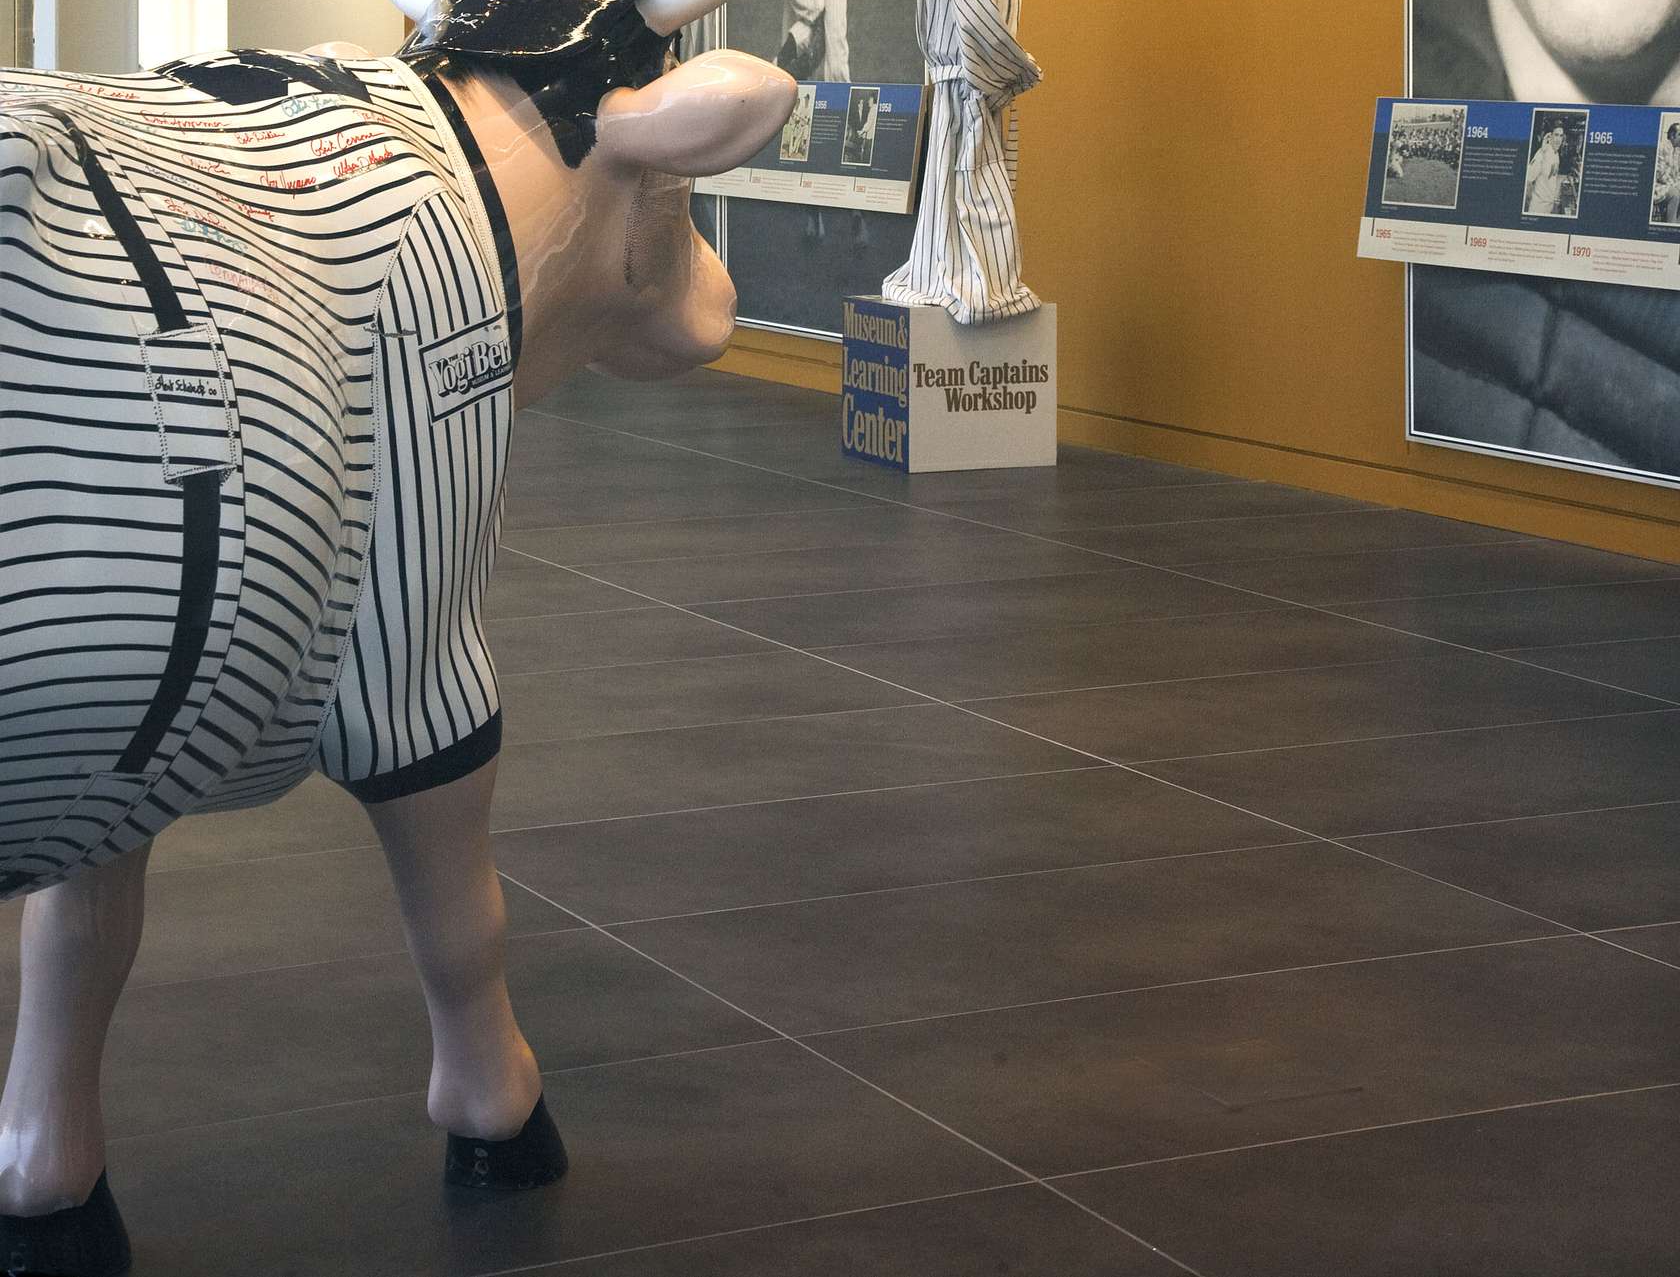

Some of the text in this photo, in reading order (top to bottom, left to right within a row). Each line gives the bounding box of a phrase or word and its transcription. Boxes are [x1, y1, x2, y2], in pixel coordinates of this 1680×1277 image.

[1466, 126, 1489, 139] 1964
[1588, 131, 1613, 145] 1965
[1470, 236, 1488, 248] 1969
[1572, 246, 1591, 258] 1970
[843, 301, 908, 350] Museum &
[428, 339, 512, 398] Yogi Berr
[843, 346, 908, 408] Learning
[913, 359, 1049, 390] Team Captains
[944, 385, 1037, 414] Workshop
[842, 392, 907, 464] Center
